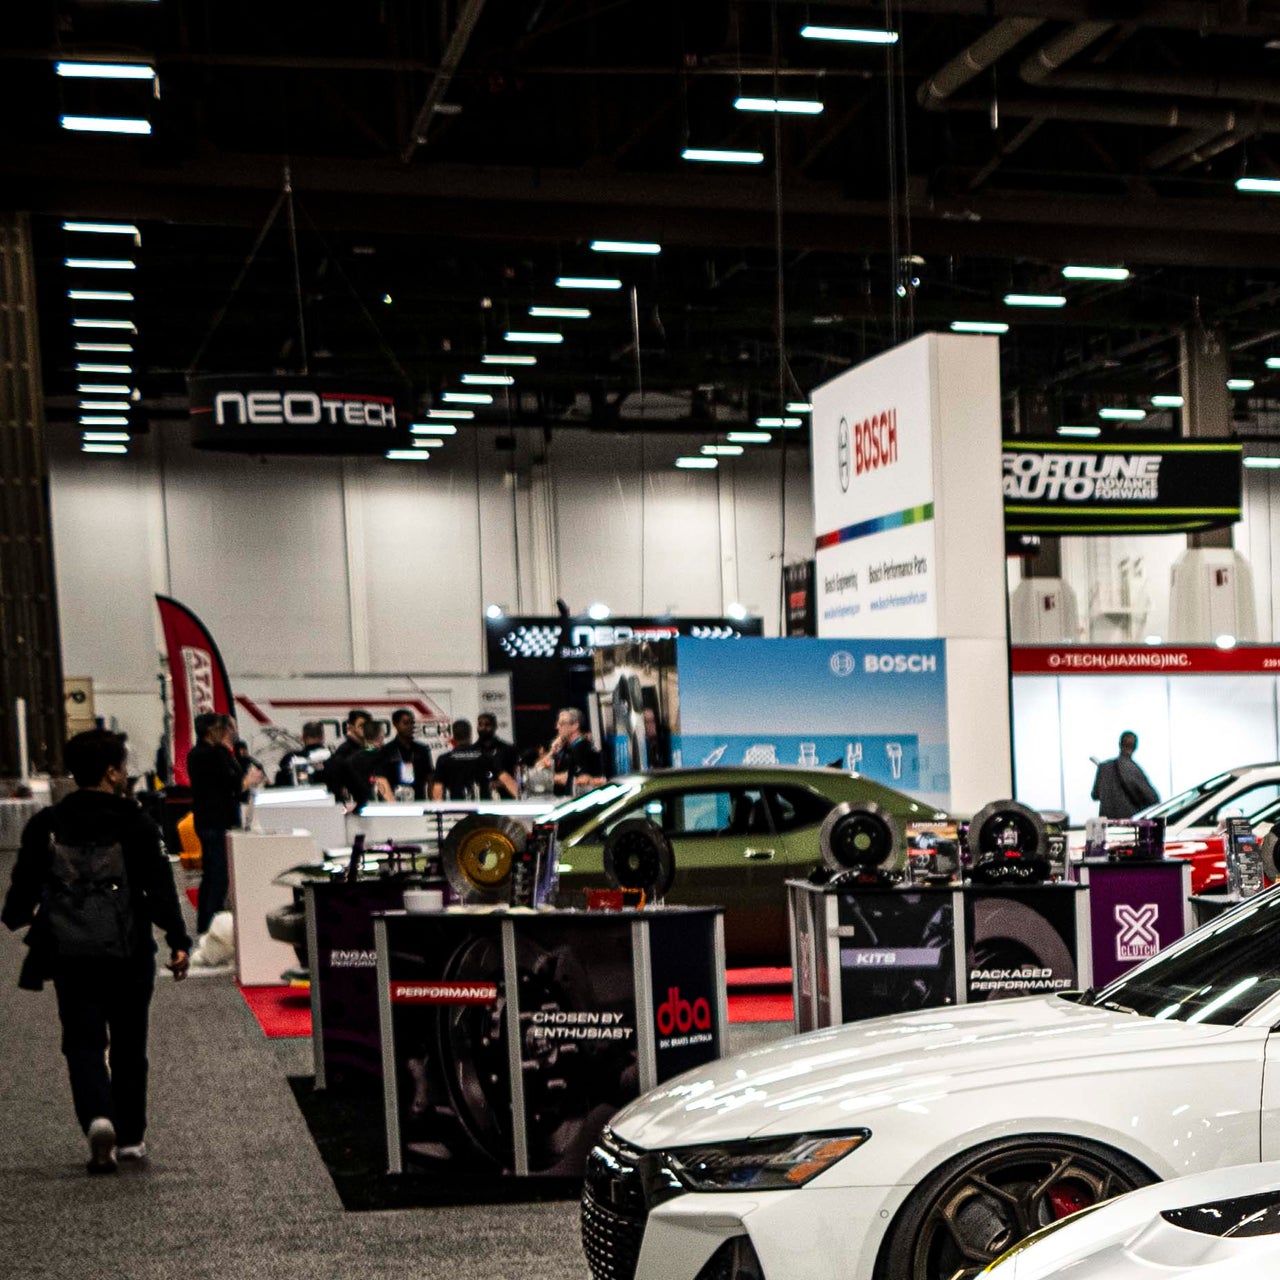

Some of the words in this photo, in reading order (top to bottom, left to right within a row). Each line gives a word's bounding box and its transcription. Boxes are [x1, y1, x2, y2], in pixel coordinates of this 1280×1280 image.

[215, 391, 396, 428] NEOTECH
[855, 408, 898, 476] BOSCH
[1001, 453, 1162, 479] FORTUNE
[1002, 477, 1097, 500] AUTO
[1096, 477, 1158, 489] ADVANCE
[864, 654, 937, 673] BOSCH
[1120, 943, 1159, 957] CLUTCH
[857, 952, 896, 964] KITS
[970, 968, 1053, 980] PACKAGED
[970, 979, 1073, 991] PERFORMANCE
[396, 986, 497, 999] PERFORMANCE
[533, 1012, 599, 1024] CHOSEN
[601, 1013, 624, 1024] BY
[657, 987, 711, 1036] dba
[533, 1027, 633, 1040] ENTHUSIAST
